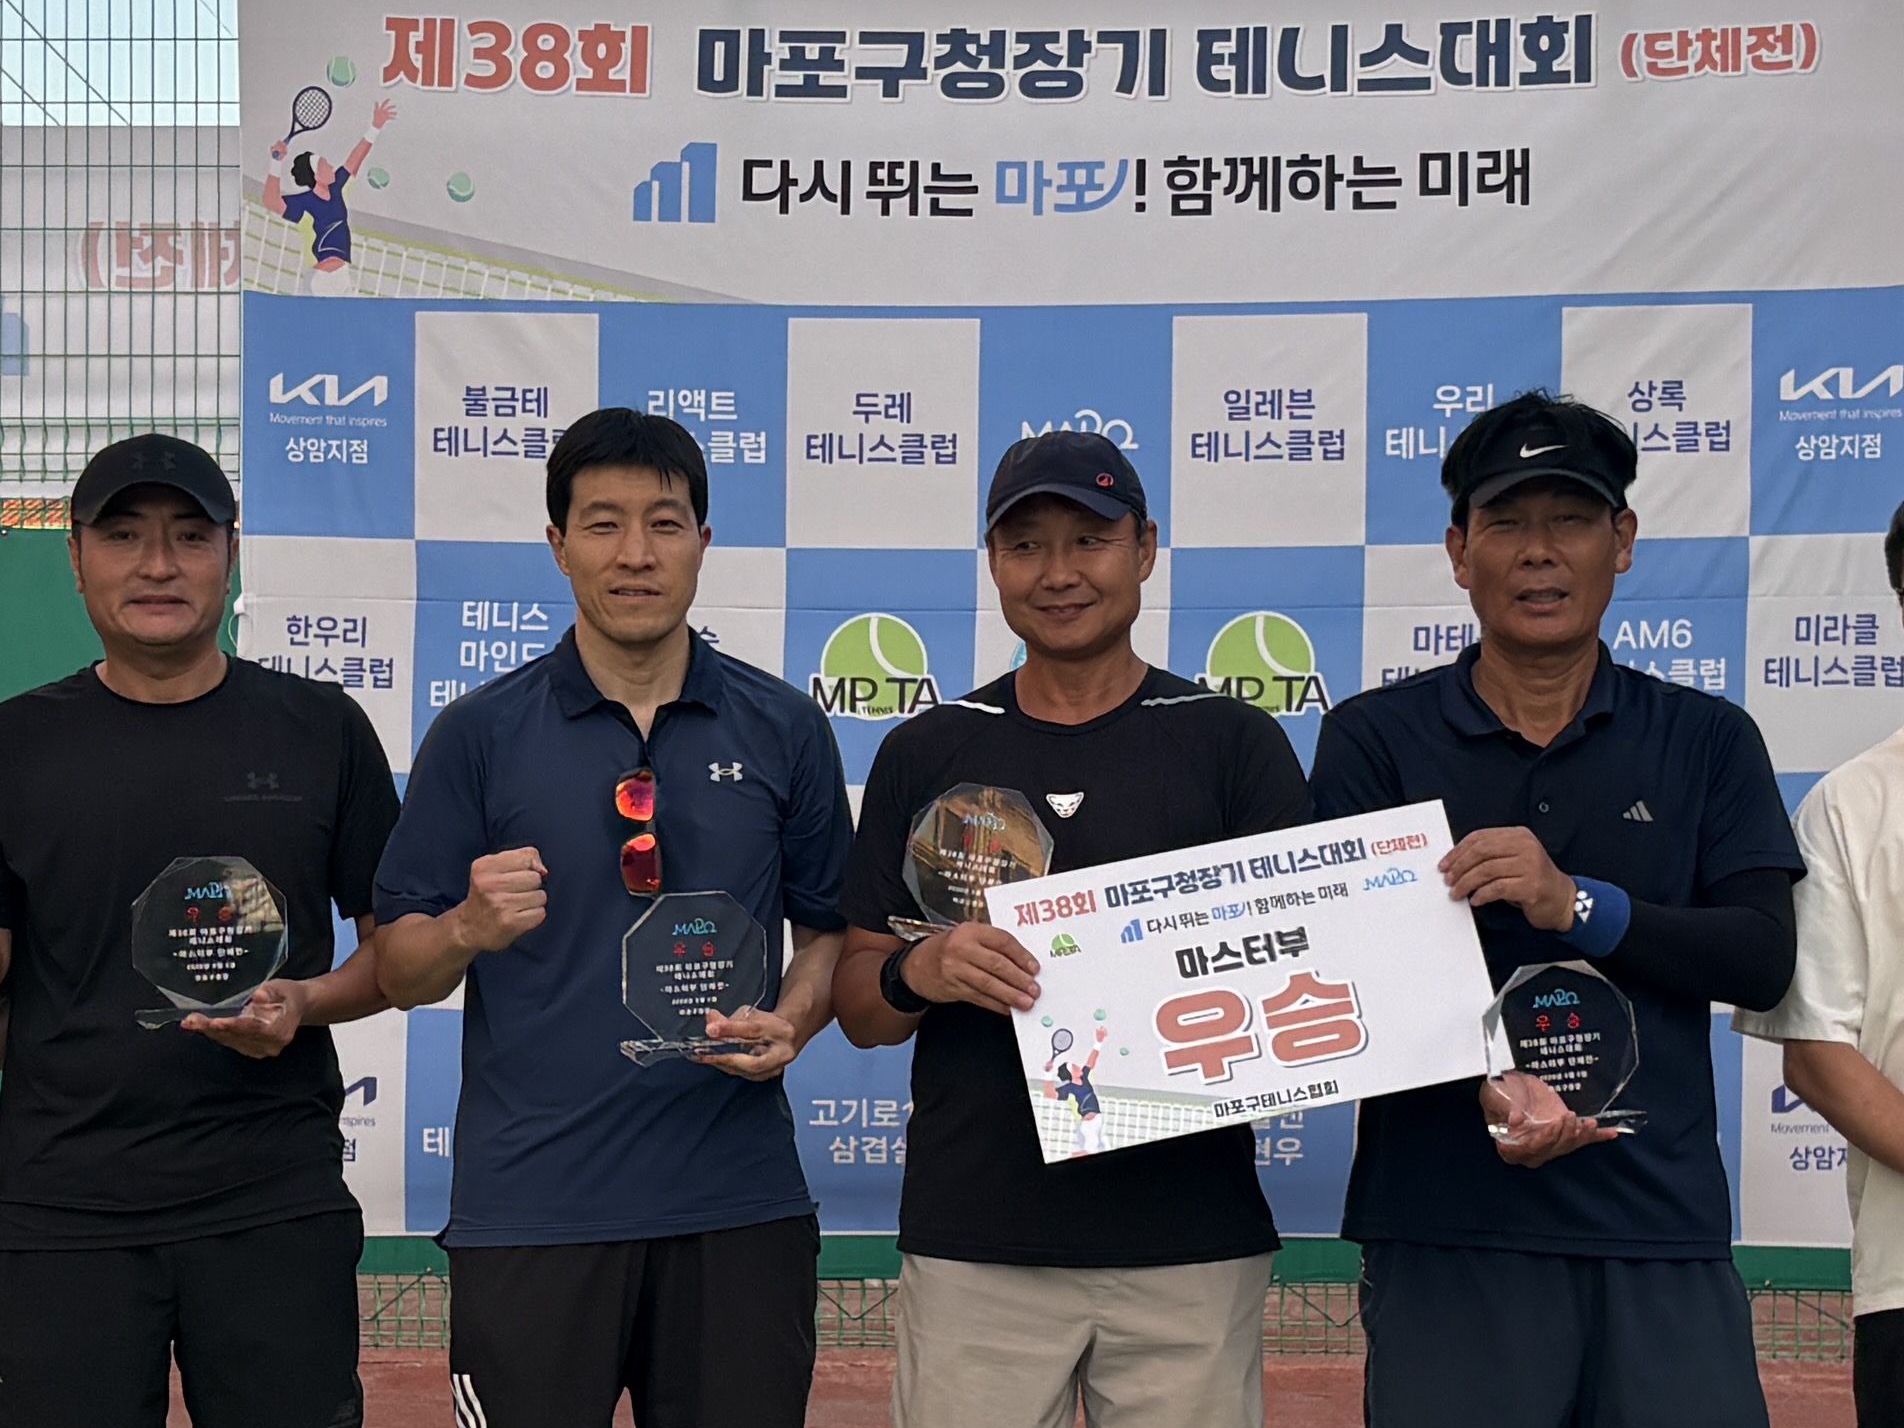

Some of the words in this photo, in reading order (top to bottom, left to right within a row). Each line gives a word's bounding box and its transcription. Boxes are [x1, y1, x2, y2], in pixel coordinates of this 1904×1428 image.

[382, 17, 650, 94] 제38회
[697, 27, 1168, 101] 마포구청장기
[1197, 15, 1594, 93] 테니스대회
[1621, 22, 1821, 80] (단체전)
[743, 159, 852, 217] 다시
[866, 160, 978, 217] 뛰는
[1163, 153, 1402, 216] 함께하는
[1419, 147, 1532, 207] 미래
[269, 372, 388, 406] KIA
[1628, 379, 1688, 412] 상록
[1780, 365, 1904, 401] KIA
[462, 386, 548, 418] 불금테
[647, 390, 738, 421] 리액트
[852, 391, 912, 425] 두레
[1222, 387, 1316, 423] 일레븐
[1433, 384, 1494, 418] 우리
[1779, 409, 1837, 421] Movement
[1839, 409, 1861, 420] that
[1863, 408, 1903, 421] inspires
[269, 412, 324, 425] Movement
[326, 413, 346, 426] that
[349, 415, 388, 428] inspires
[285, 437, 369, 465] 상암지점
[806, 431, 958, 466] 테니스클럽
[1191, 425, 1347, 464] 테니스클럽
[1385, 426, 1452, 460] 테니
[1795, 433, 1882, 461] 상암지점
[286, 615, 368, 648] 한우리
[462, 601, 549, 633] 테니스
[1613, 618, 1694, 650] AM6
[1795, 613, 1880, 646] 미라클
[1413, 623, 1479, 656] 마테
[1629, 657, 1726, 691] 스클럽
[1014, 889, 1098, 928] 제38회
[1105, 859, 1246, 908] 마포구청장기
[1248, 837, 1367, 880] 테니스대회
[1147, 914, 1178, 934] 다시
[1254, 890, 1316, 915] 함께하는
[1317, 881, 1350, 900] 미래
[1176, 925, 1310, 979] 마스터부
[1155, 972, 1365, 1081] 우승
[1214, 1078, 1340, 1119] 마포구테니스협회
